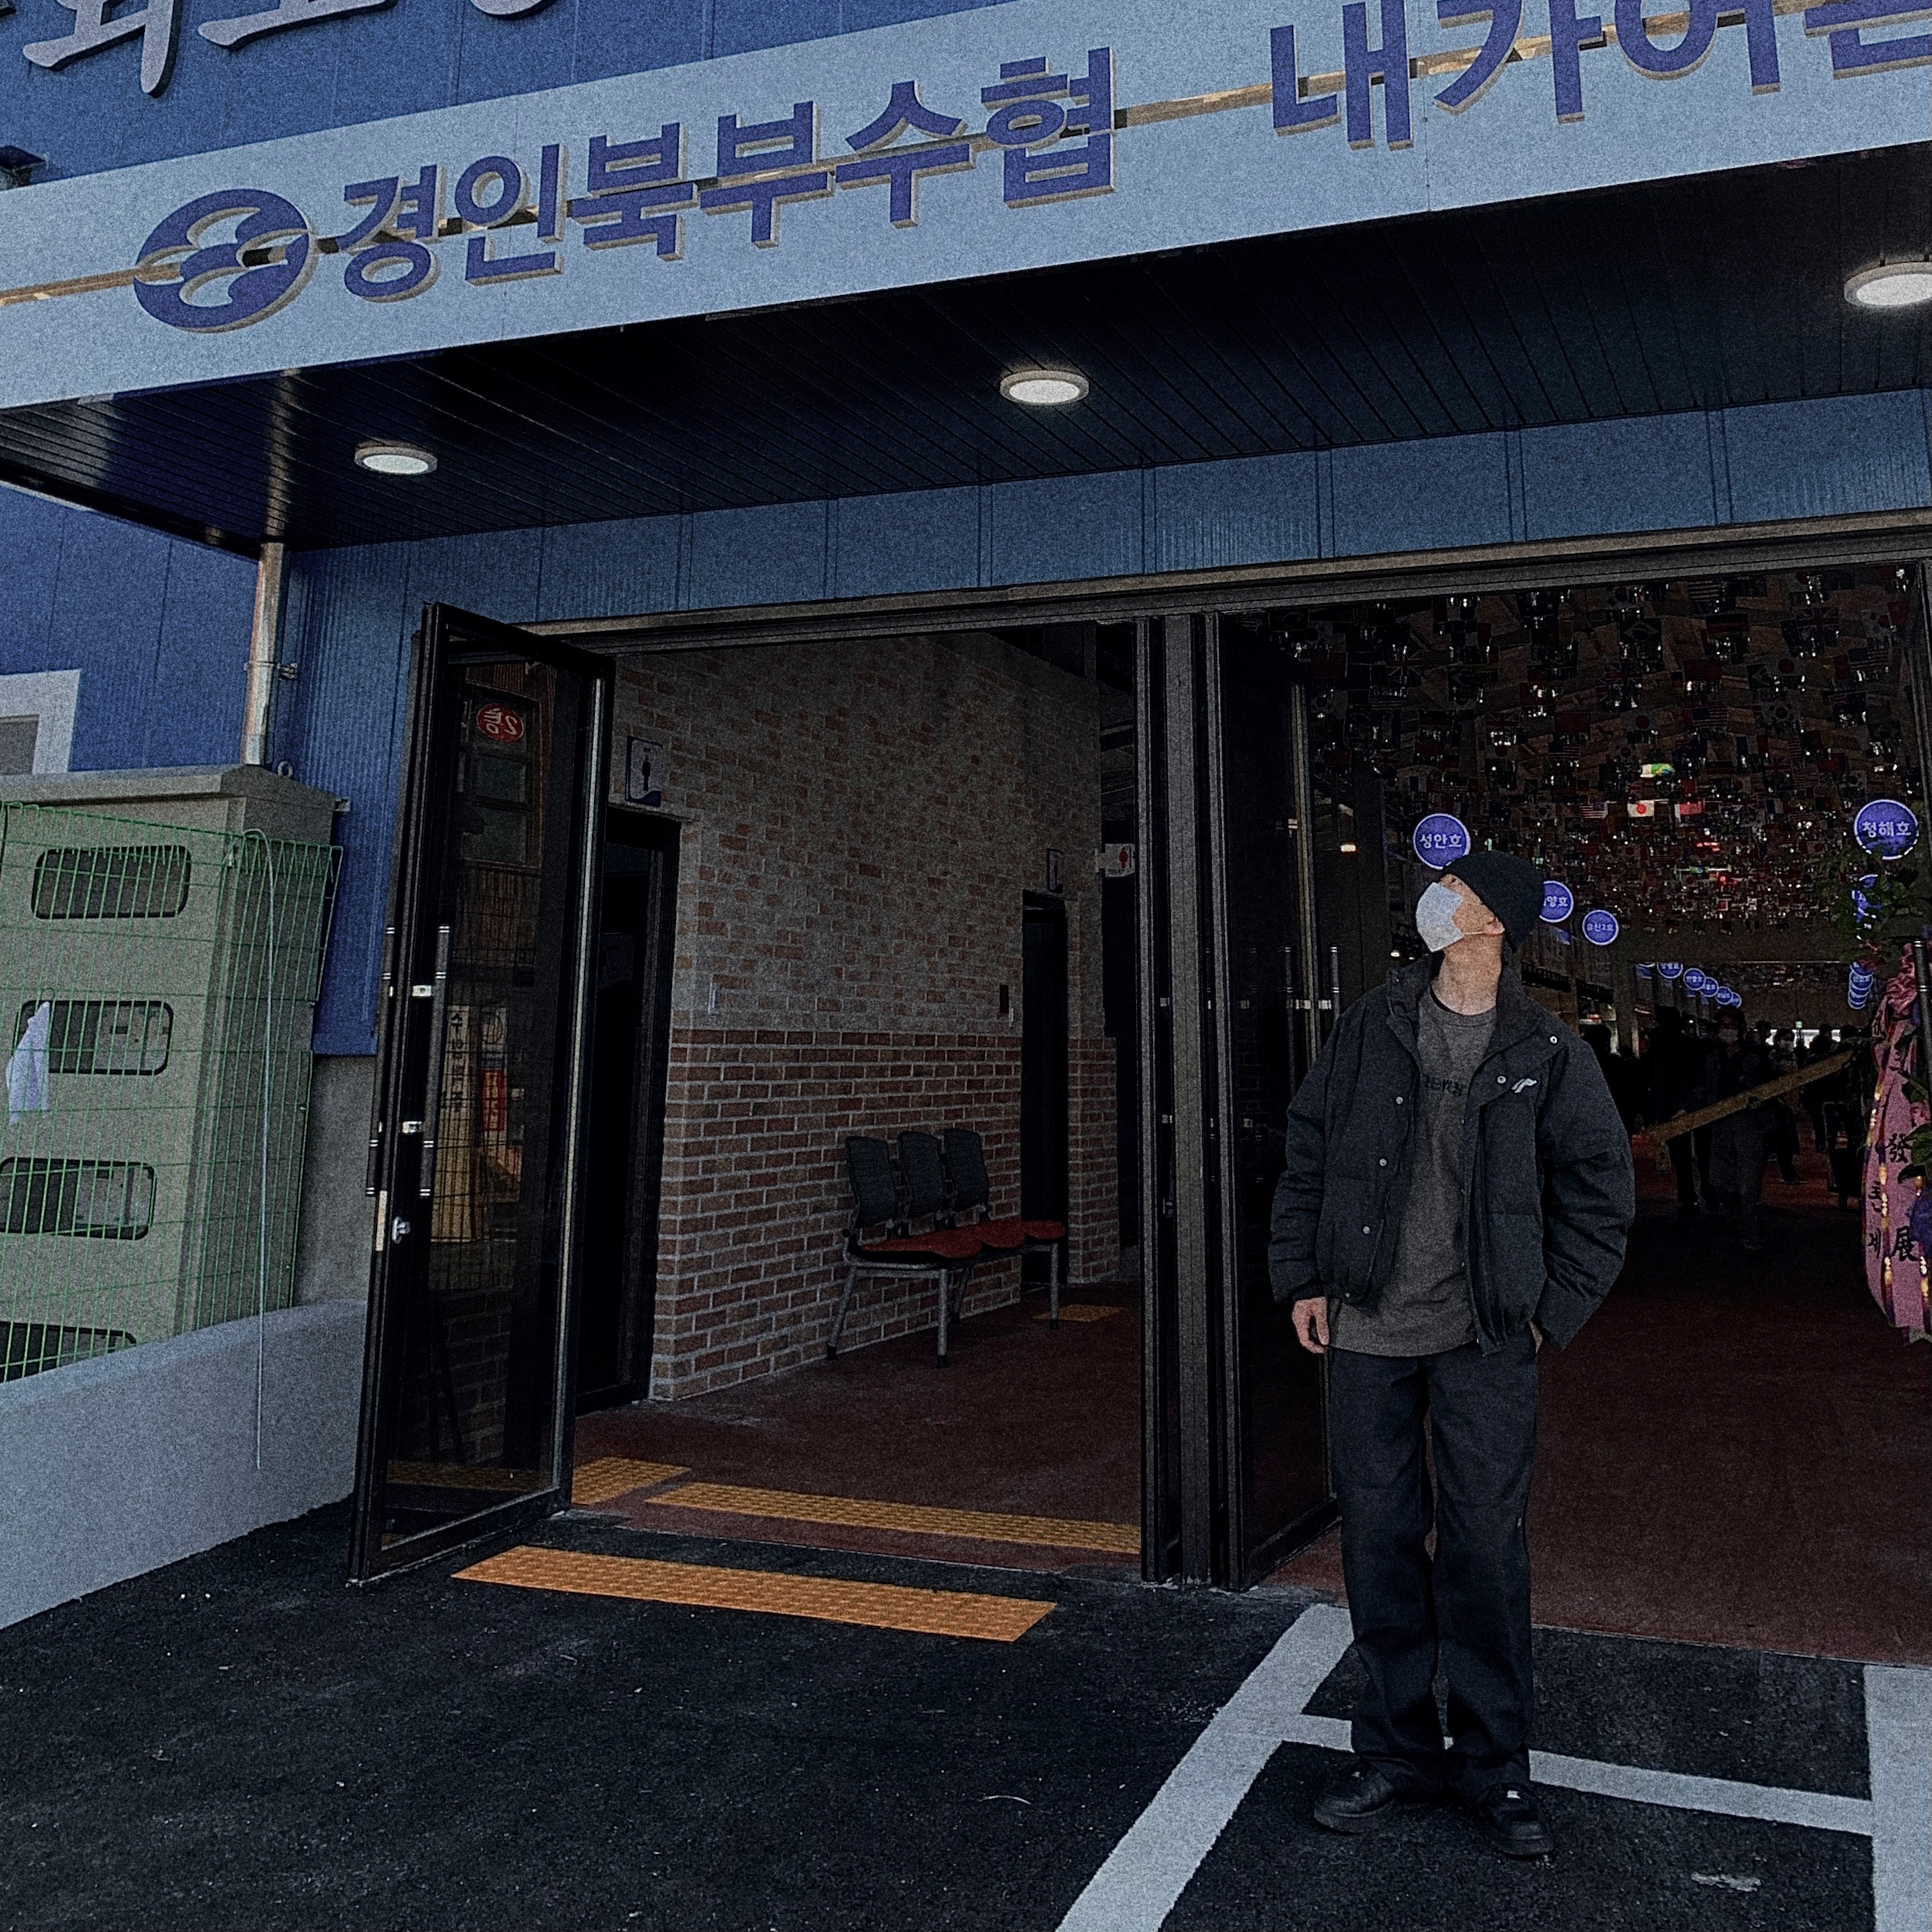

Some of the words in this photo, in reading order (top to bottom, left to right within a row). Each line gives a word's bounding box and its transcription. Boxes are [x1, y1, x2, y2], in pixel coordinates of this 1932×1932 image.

[339, 47, 1115, 302] 경인북부수협
[1862, 821, 1911, 838] 청해호
[1419, 834, 1463, 849] 성안호
[1543, 895, 1568, 907] 양호
